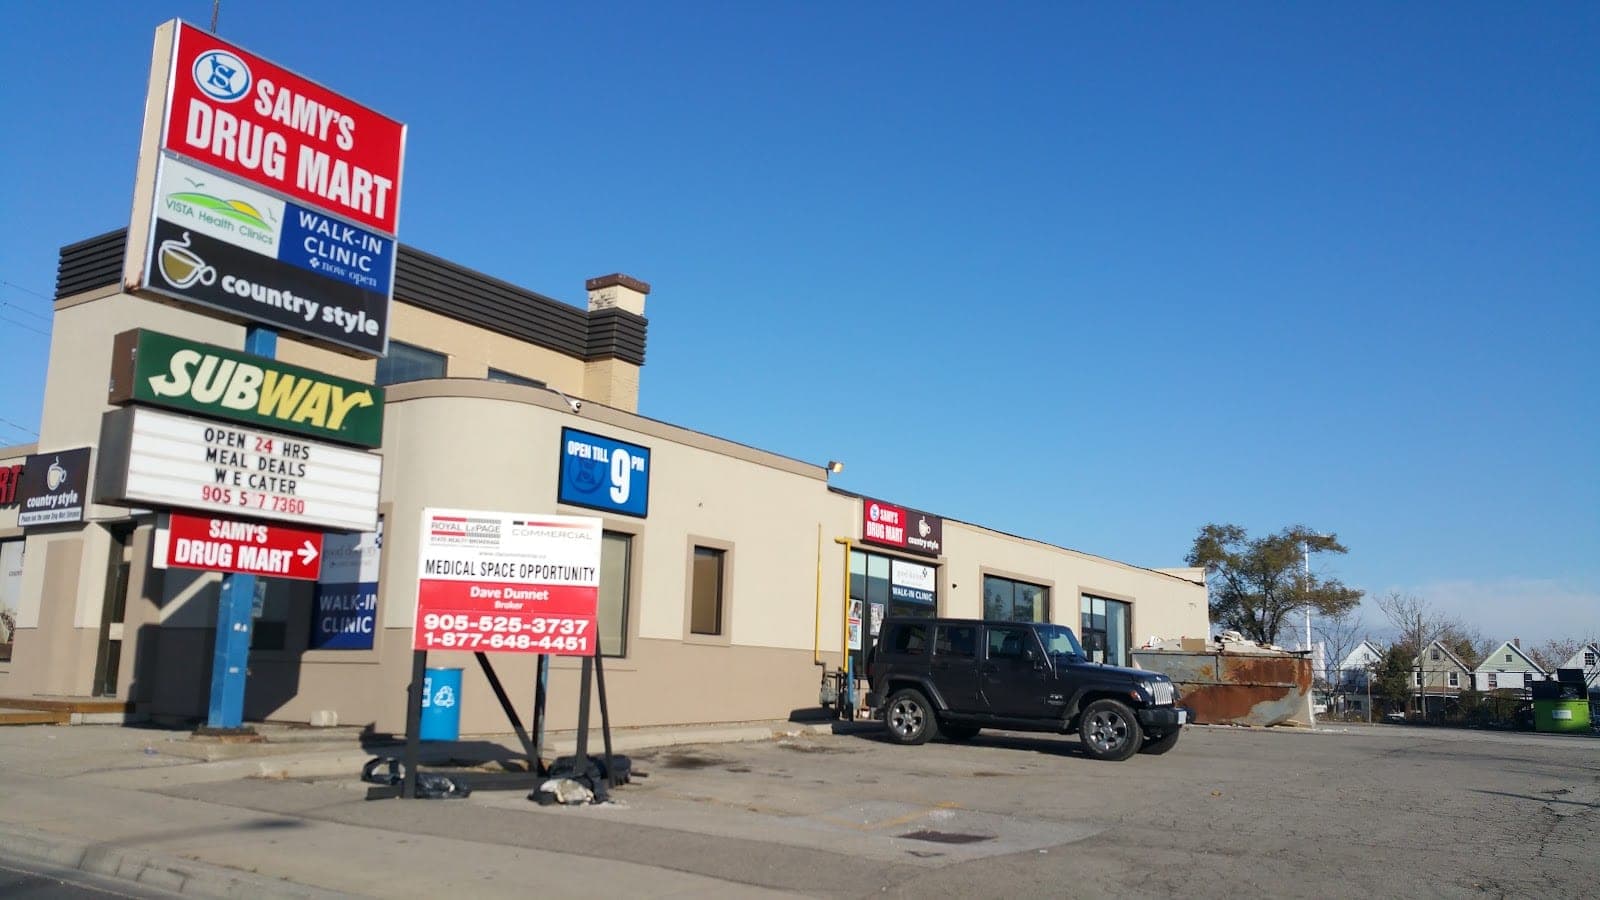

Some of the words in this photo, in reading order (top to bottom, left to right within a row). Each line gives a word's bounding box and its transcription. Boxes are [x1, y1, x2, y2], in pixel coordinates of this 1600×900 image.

[254, 78, 355, 151] SAMY'S
[185, 97, 287, 181] DRUG
[297, 145, 392, 220] MART
[166, 199, 194, 217] VISTA
[199, 210, 235, 233] Health
[239, 225, 273, 246] Clinics
[299, 211, 383, 255] WALK-IN
[303, 236, 372, 272] CLINIC
[322, 262, 345, 277] now
[349, 270, 377, 287] open
[221, 275, 319, 322] country
[322, 305, 379, 336] style
[148, 349, 373, 431] SUBWAY
[204, 427, 246, 448] OPEN
[255, 436, 273, 453] 24
[282, 442, 310, 460] HRS
[206, 447, 248, 468] MEAL
[258, 456, 306, 477] DEALS
[567, 440, 592, 459] OPEN
[592, 445, 609, 463] TILL
[610, 448, 631, 504] 9
[631, 455, 645, 472] PM
[248, 474, 296, 495] CATER
[27, 494, 58, 509] country
[58, 489, 78, 507] style
[202, 485, 231, 504] 905
[272, 495, 304, 514] 7360
[208, 519, 268, 544] SAMY'S
[431, 522, 461, 531] ROYAL
[511, 528, 592, 540] COMMERCIAL
[866, 520, 885, 539] DRUG
[885, 525, 904, 543] MART
[175, 538, 232, 568] DRUG
[237, 547, 293, 574] MART
[907, 536, 927, 549] country
[926, 540, 939, 551] style
[425, 559, 476, 576] MEDICAL
[480, 561, 515, 578] SPACE
[519, 563, 595, 581] OPPORTUNITY
[470, 586, 501, 599] Dave
[504, 587, 549, 601] Dunnet
[494, 600, 524, 610] Broker
[892, 586, 914, 599] WALK-IN
[915, 591, 933, 602] CLINIC
[322, 616, 373, 633] CLINIC
[424, 613, 589, 635] 905-525-3737
[424, 632, 587, 650] 1-877-648-4451
